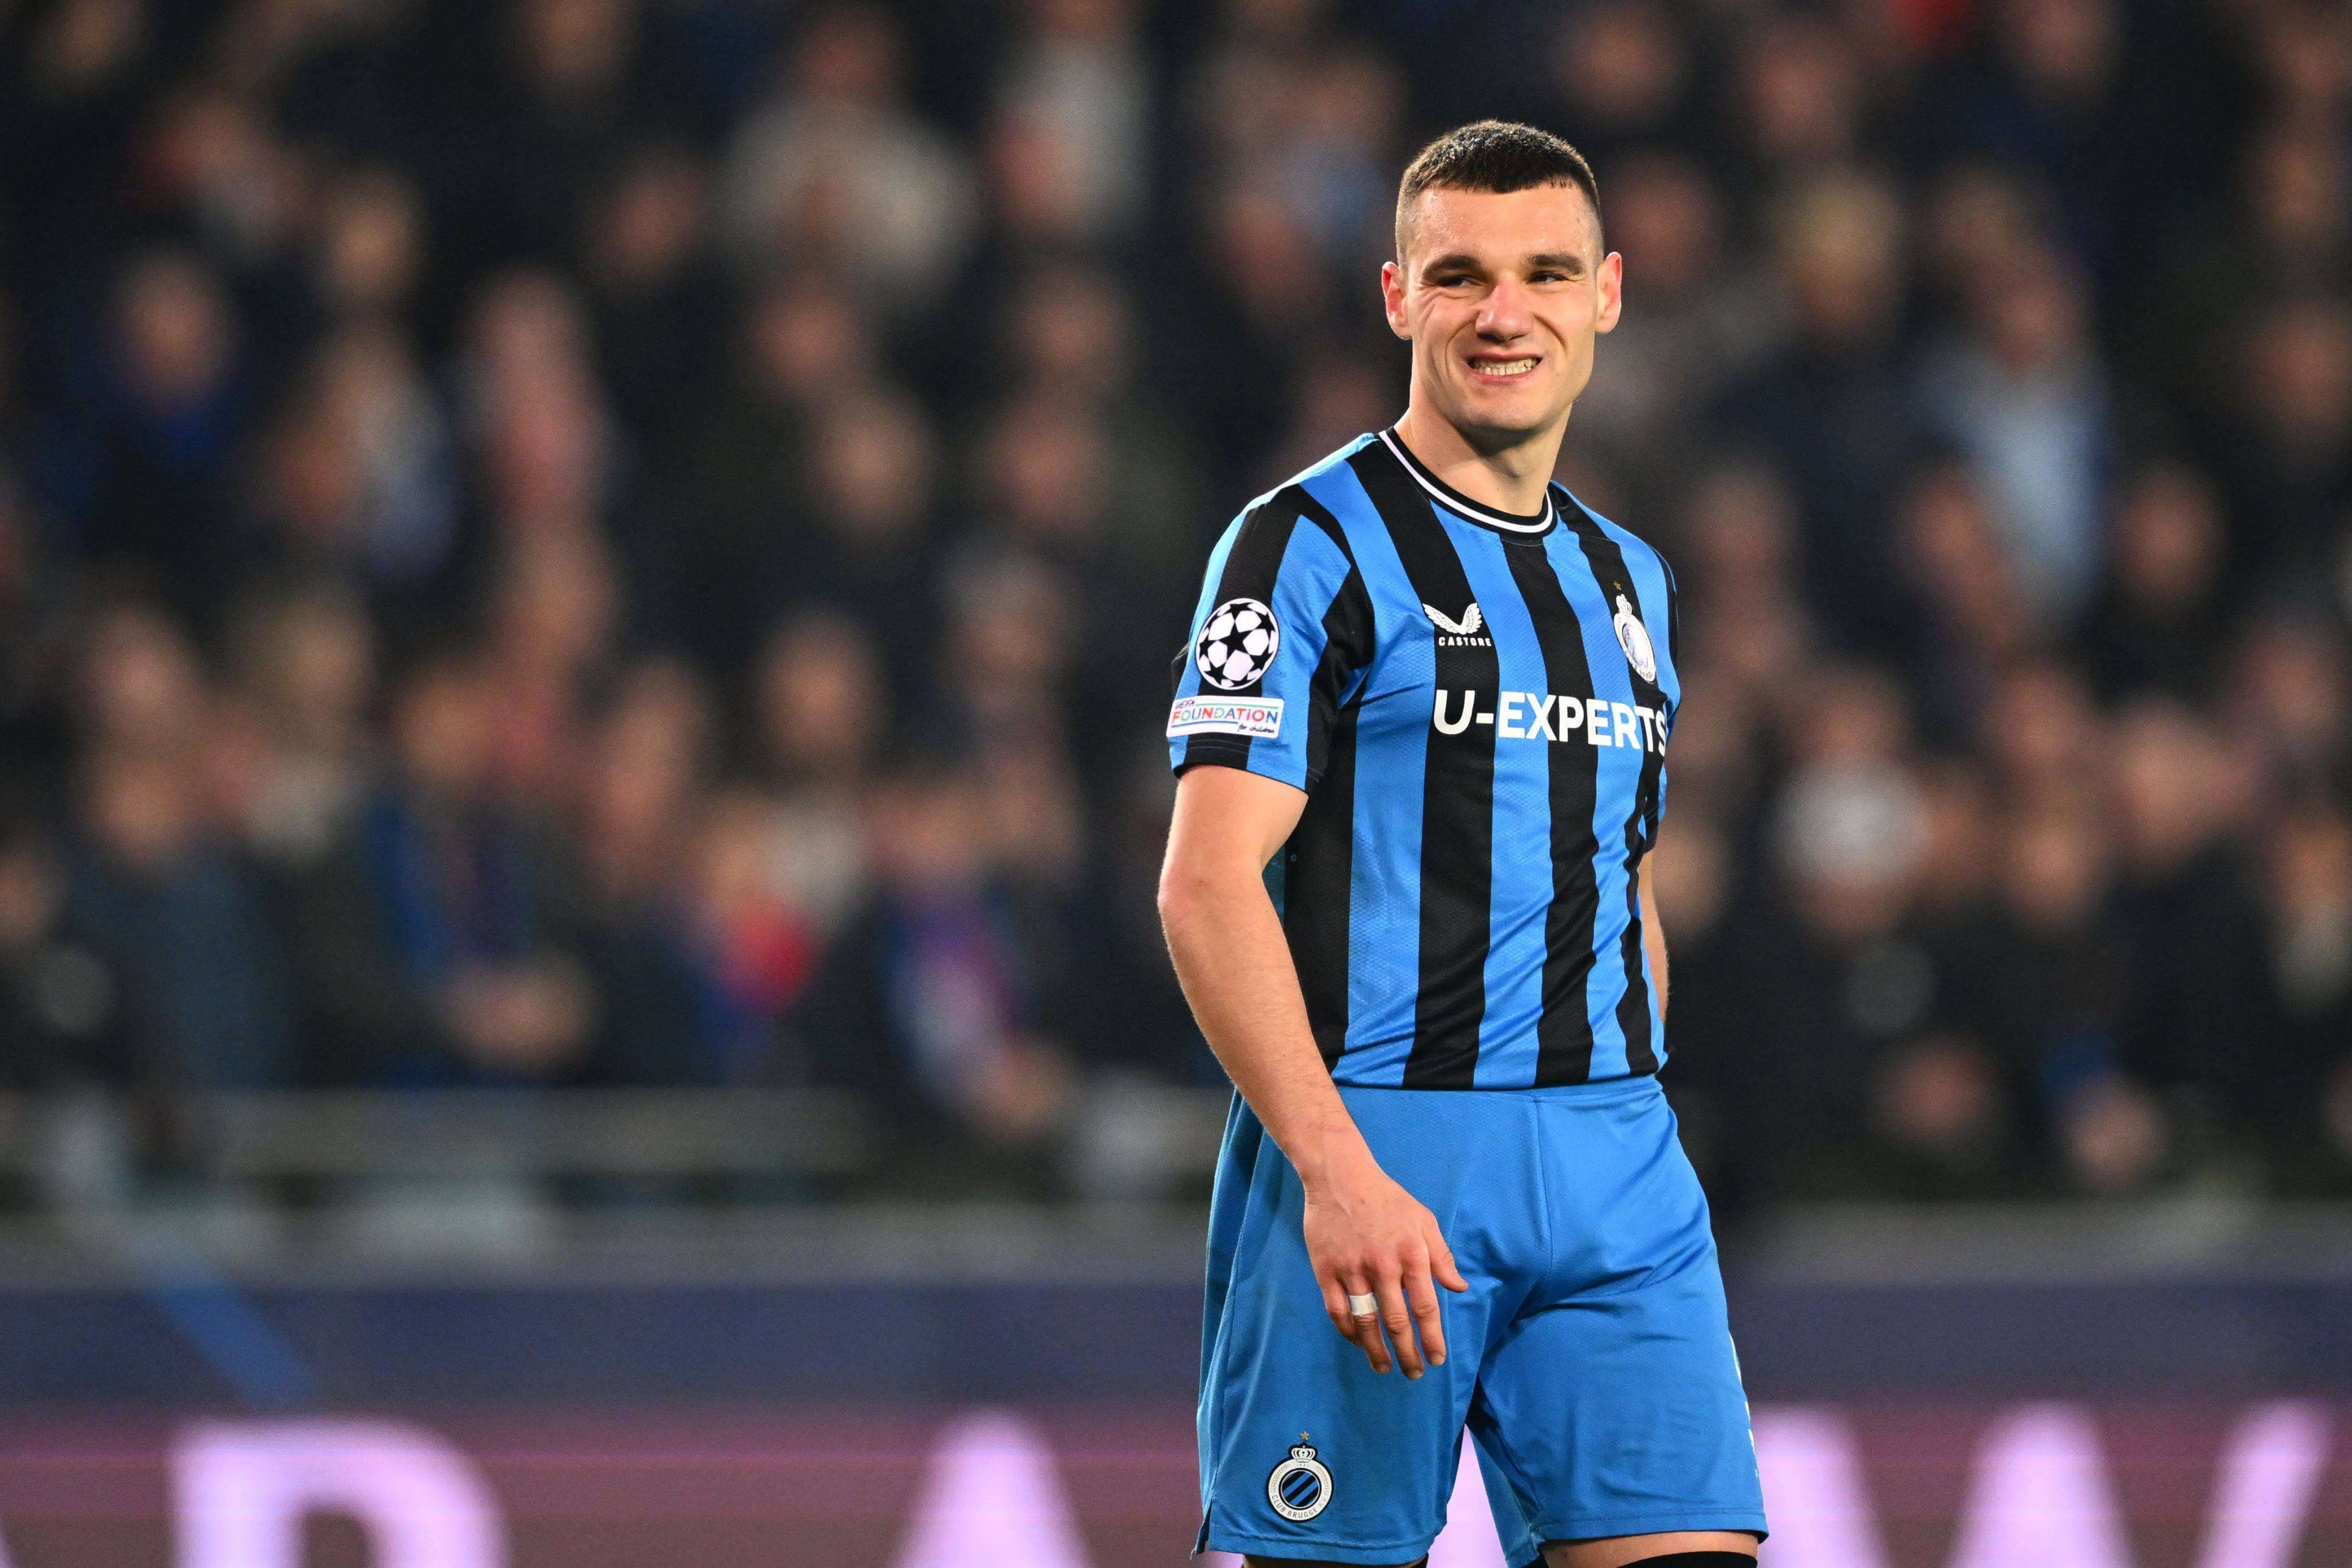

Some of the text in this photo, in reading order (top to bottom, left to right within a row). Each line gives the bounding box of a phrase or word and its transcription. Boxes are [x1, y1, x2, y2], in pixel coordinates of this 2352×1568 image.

[1438, 636, 1492, 647] CASTORE
[1175, 700, 1195, 709] UEFA
[1238, 723, 1275, 734] for children
[1433, 689, 1666, 757] U-EXPERTS
[1272, 1495, 1286, 1512] CLUB
[1287, 1507, 1318, 1518] BRUGGE
